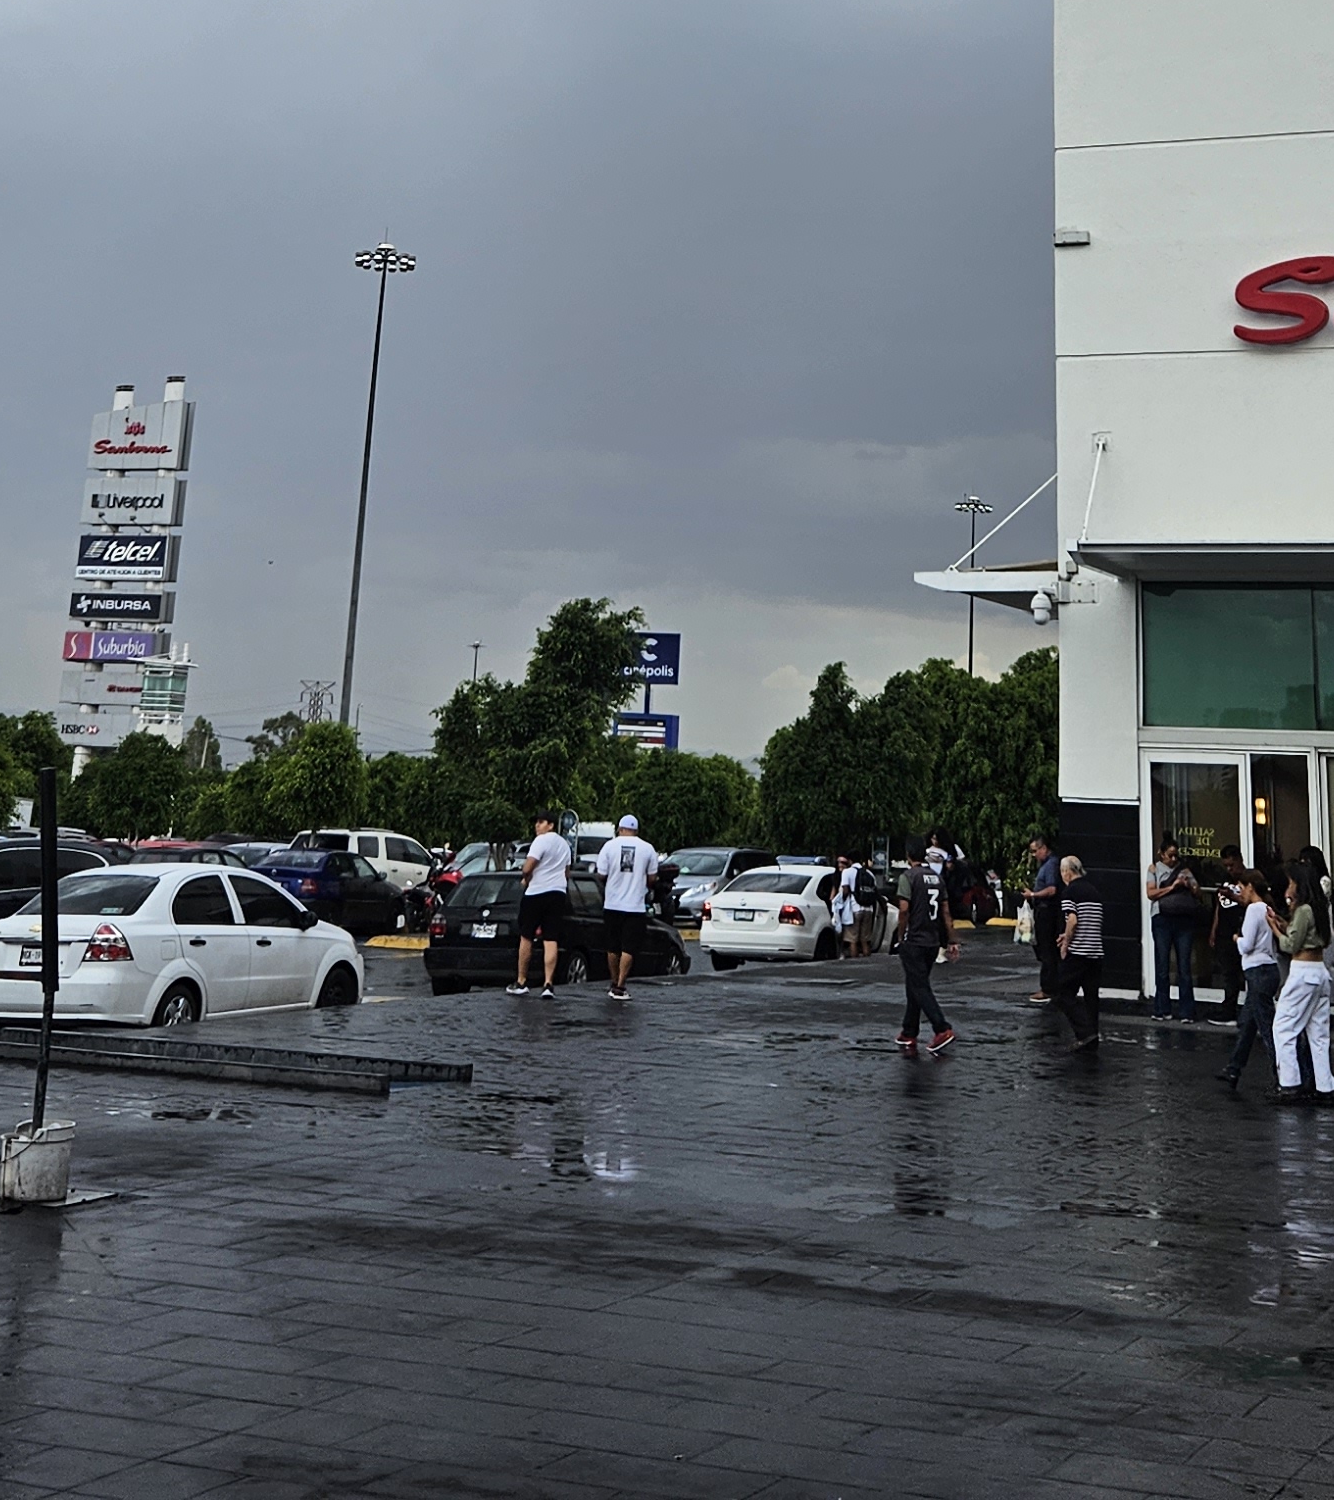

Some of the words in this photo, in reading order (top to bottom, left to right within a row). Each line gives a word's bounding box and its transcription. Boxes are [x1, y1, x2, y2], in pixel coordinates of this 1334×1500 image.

[93, 438, 173, 455] Sanborns
[107, 493, 165, 512] Liverpool
[102, 540, 162, 562] telcel
[91, 600, 151, 611] INBURSA
[96, 637, 146, 658] Suburbia
[60, 724, 86, 735] HSBC
[927, 888, 939, 920] 3
